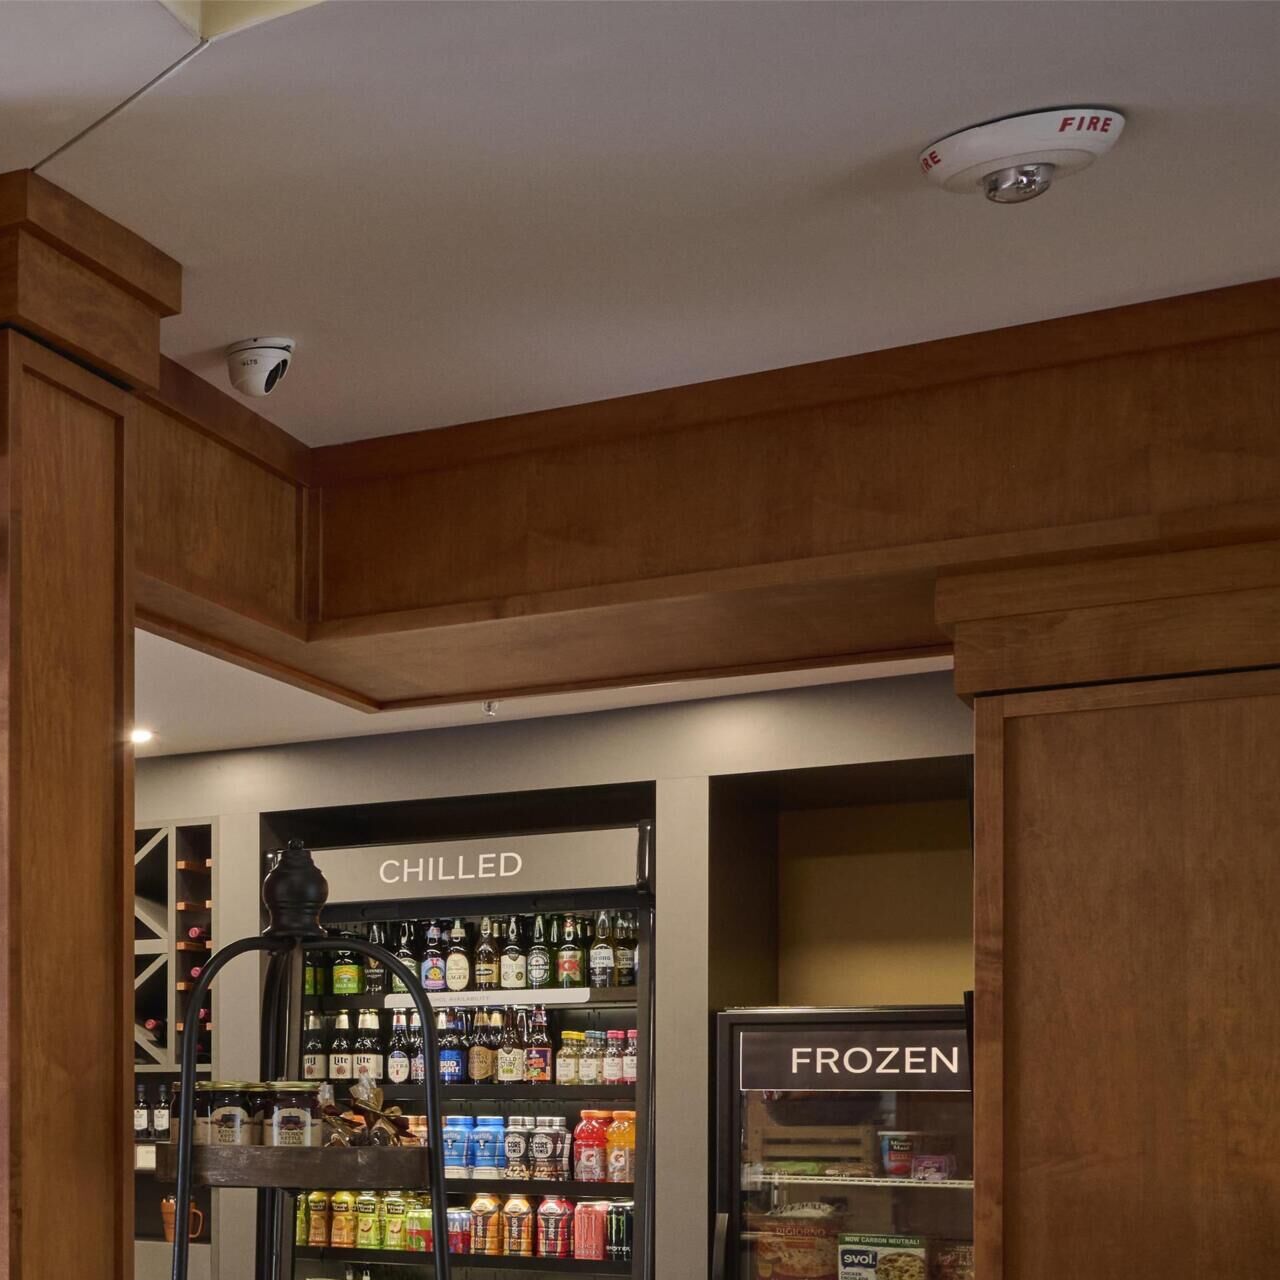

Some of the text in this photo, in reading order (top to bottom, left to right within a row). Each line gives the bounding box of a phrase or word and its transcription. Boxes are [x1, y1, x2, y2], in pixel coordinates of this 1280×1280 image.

[1058, 116, 1112, 133] FIRE
[379, 852, 523, 884] CHILLED
[333, 1056, 349, 1065] Lite
[356, 1056, 371, 1065] Lite
[791, 1046, 959, 1074] FROZEN
[534, 1142, 548, 1150] CORE
[843, 1253, 876, 1265] evol.
